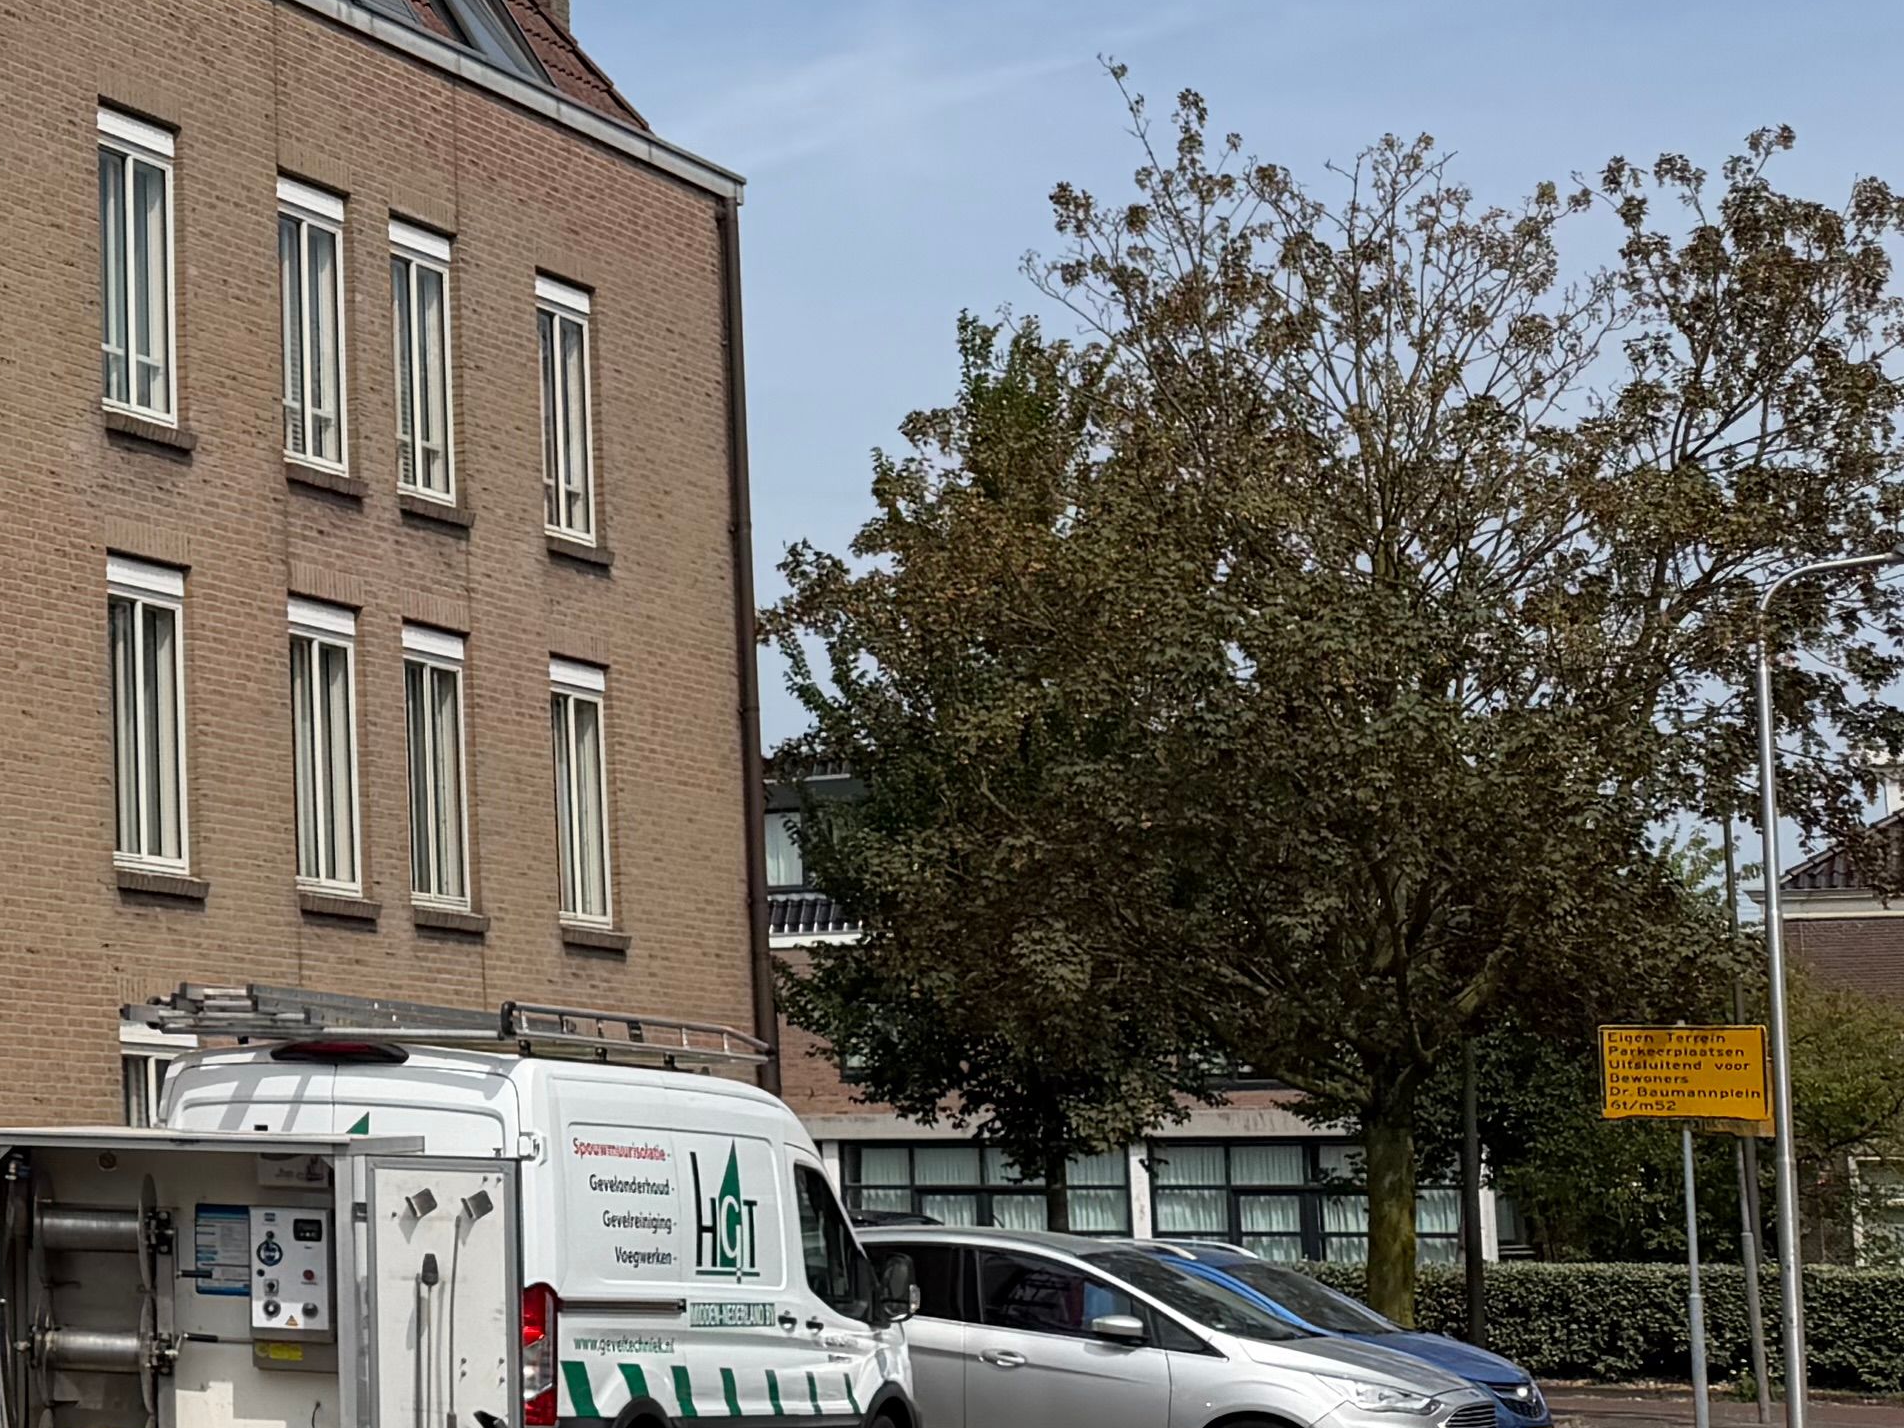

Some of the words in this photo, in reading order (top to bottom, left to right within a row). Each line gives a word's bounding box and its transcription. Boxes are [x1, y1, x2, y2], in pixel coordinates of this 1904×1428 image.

[1607, 1032, 1654, 1045] Eigen
[1667, 1032, 1726, 1044] Terrein
[1608, 1046, 1745, 1058] Parkeerplaatsen
[1609, 1060, 1702, 1071] Uitsluitend
[1714, 1061, 1750, 1071] voor
[1610, 1073, 1689, 1084] Bewoners
[690, 1151, 758, 1269] HGT
[614, 1245, 672, 1268] Voegwerken
